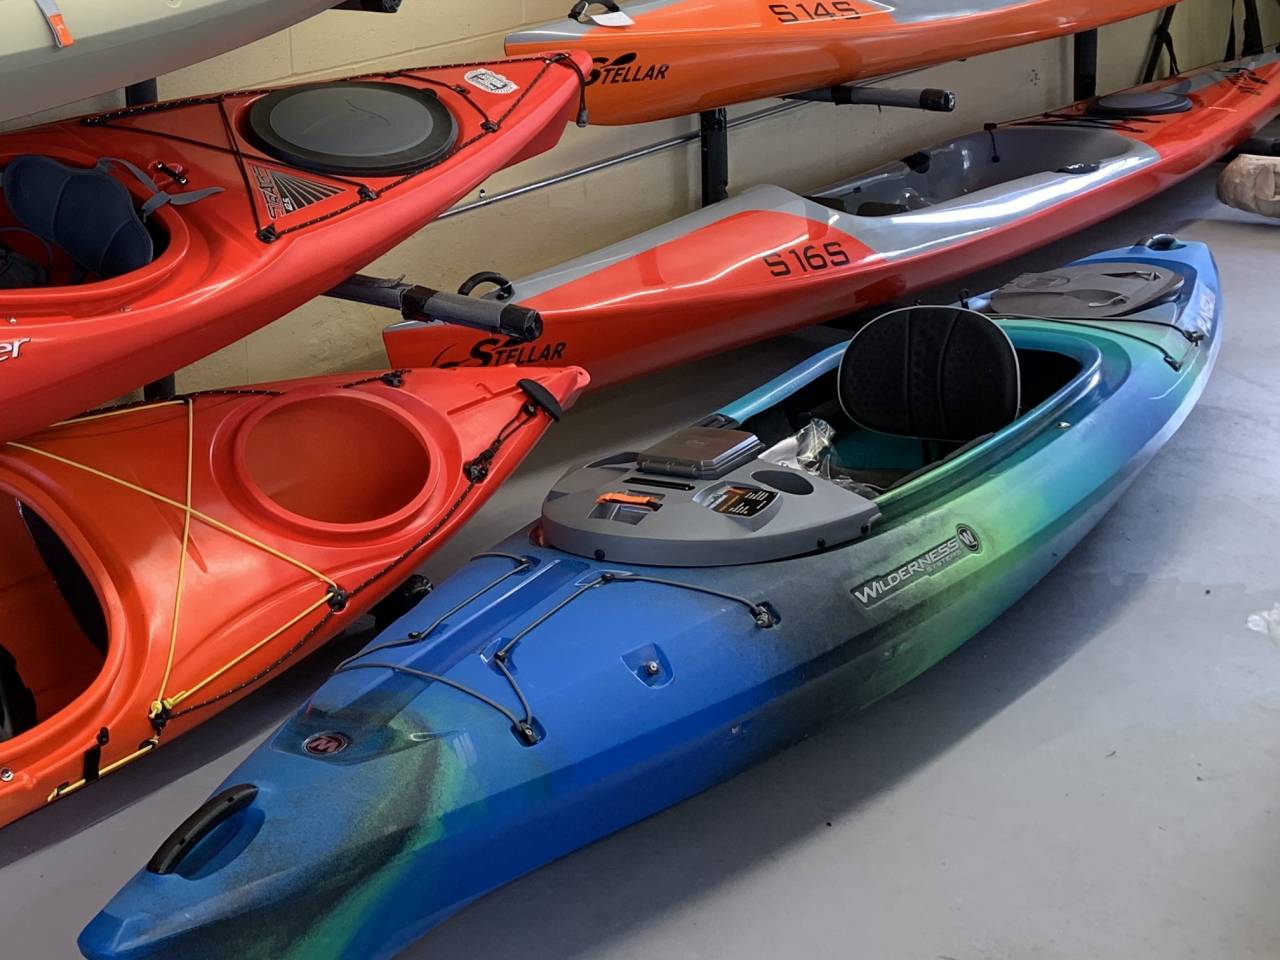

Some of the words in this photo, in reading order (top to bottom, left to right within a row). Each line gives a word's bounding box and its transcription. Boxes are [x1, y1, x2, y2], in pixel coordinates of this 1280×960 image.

[768, 1, 861, 23] S14S
[763, 242, 850, 277] S16S
[855, 538, 959, 603] WILDERNESS
